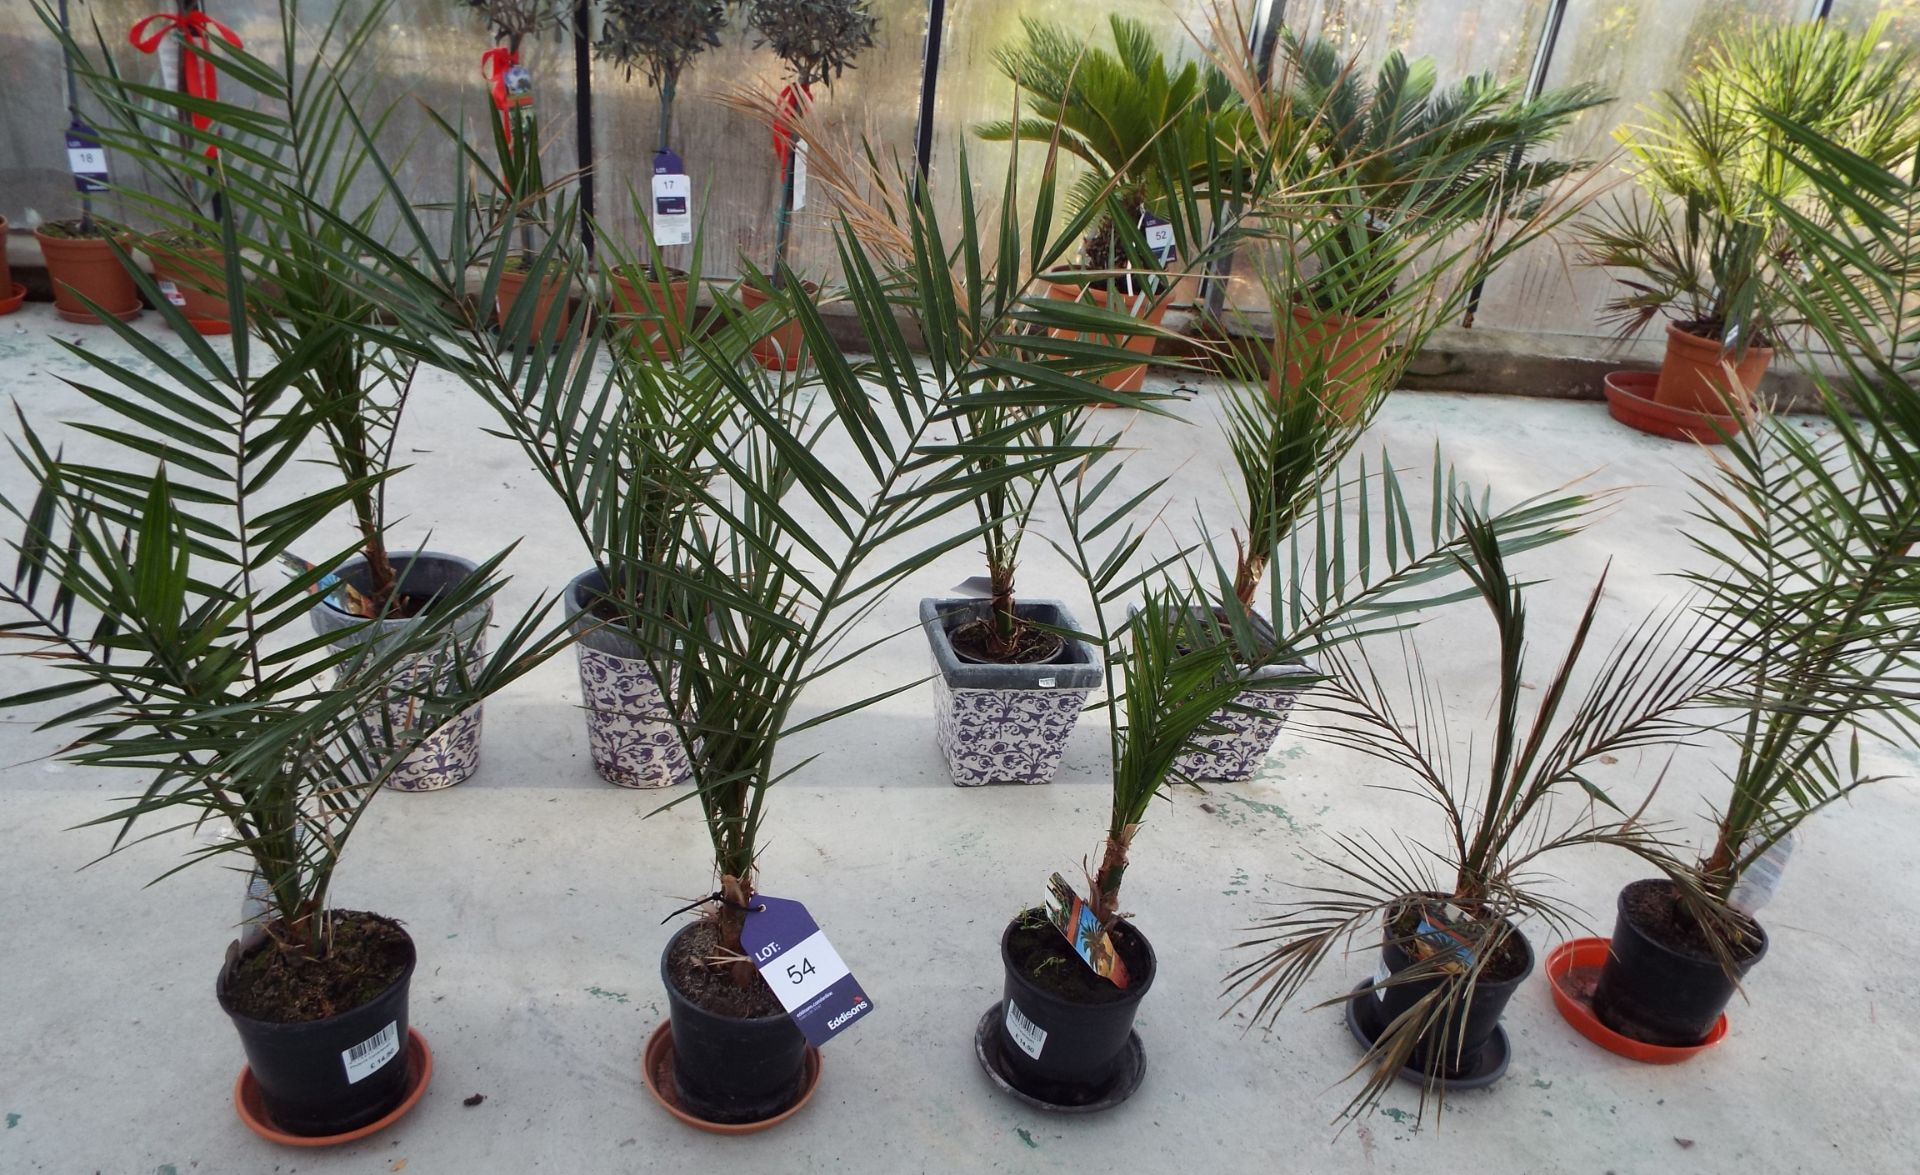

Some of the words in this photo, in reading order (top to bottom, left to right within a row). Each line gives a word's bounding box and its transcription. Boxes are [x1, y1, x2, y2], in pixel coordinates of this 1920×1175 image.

[80, 153, 94, 163] 18
[663, 180, 674, 190] 17
[1155, 230, 1167, 241] 52
[755, 941, 781, 962] LOT:
[786, 957, 816, 985] 54
[827, 1000, 868, 1031] Eddisons
